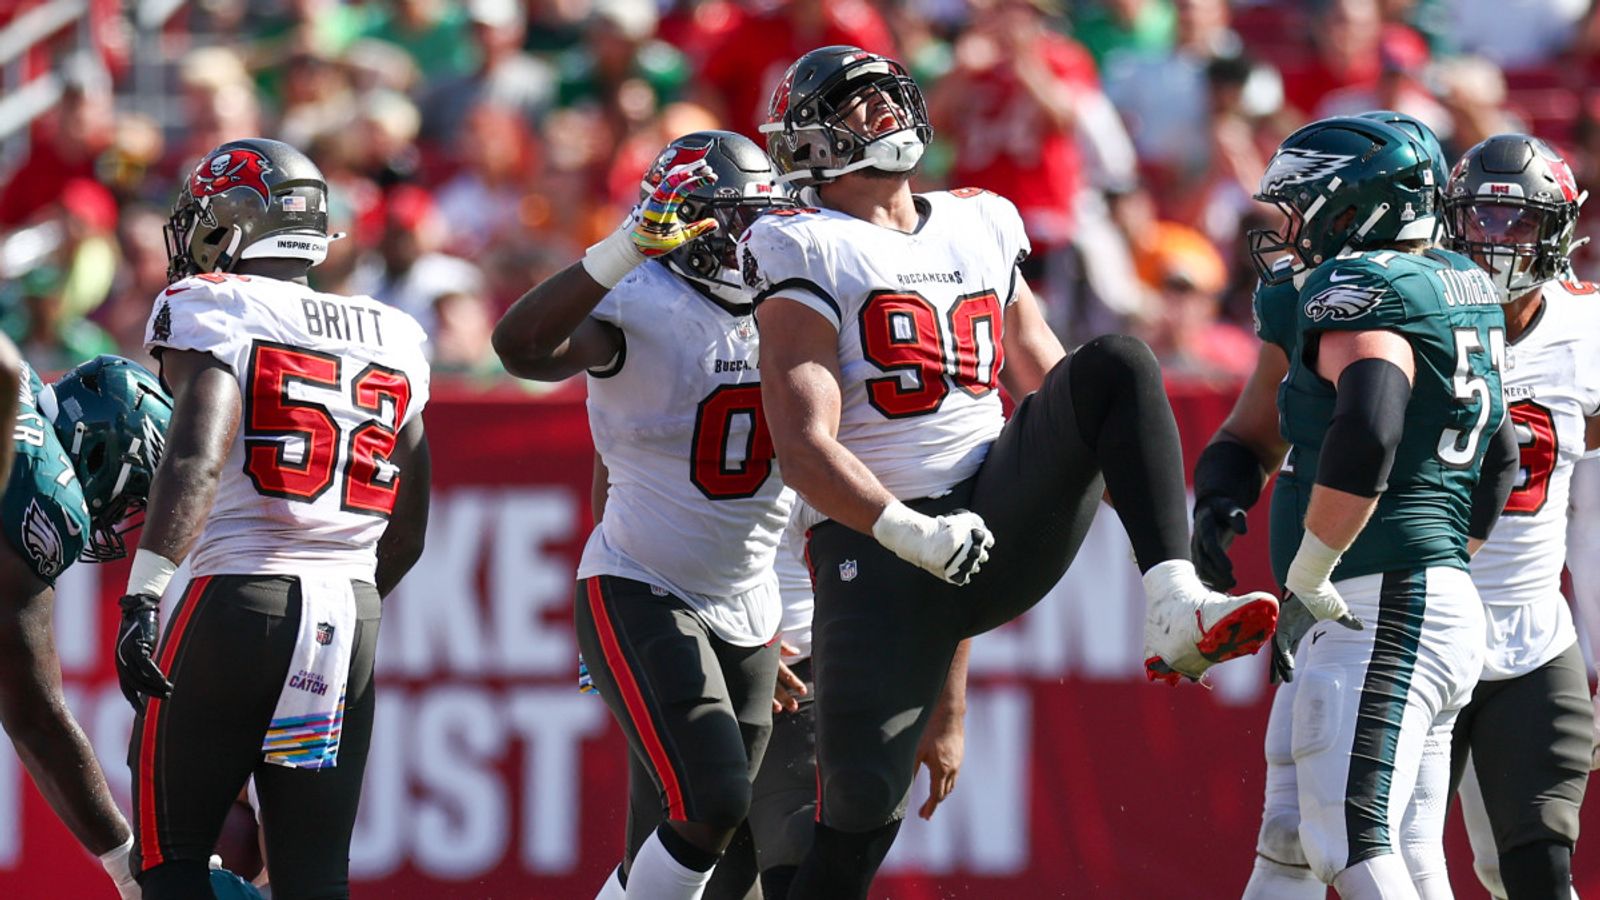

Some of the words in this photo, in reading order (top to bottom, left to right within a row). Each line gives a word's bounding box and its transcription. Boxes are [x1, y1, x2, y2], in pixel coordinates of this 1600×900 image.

[277, 240, 311, 250] INSPIRE
[897, 270, 963, 285] BUCCANEERS
[1436, 267, 1499, 307] JURGEN
[301, 298, 384, 346] BRITT
[858, 288, 1004, 419] 90
[243, 338, 411, 519] 52
[690, 381, 776, 500] 0
[288, 675, 329, 696] CATCH
